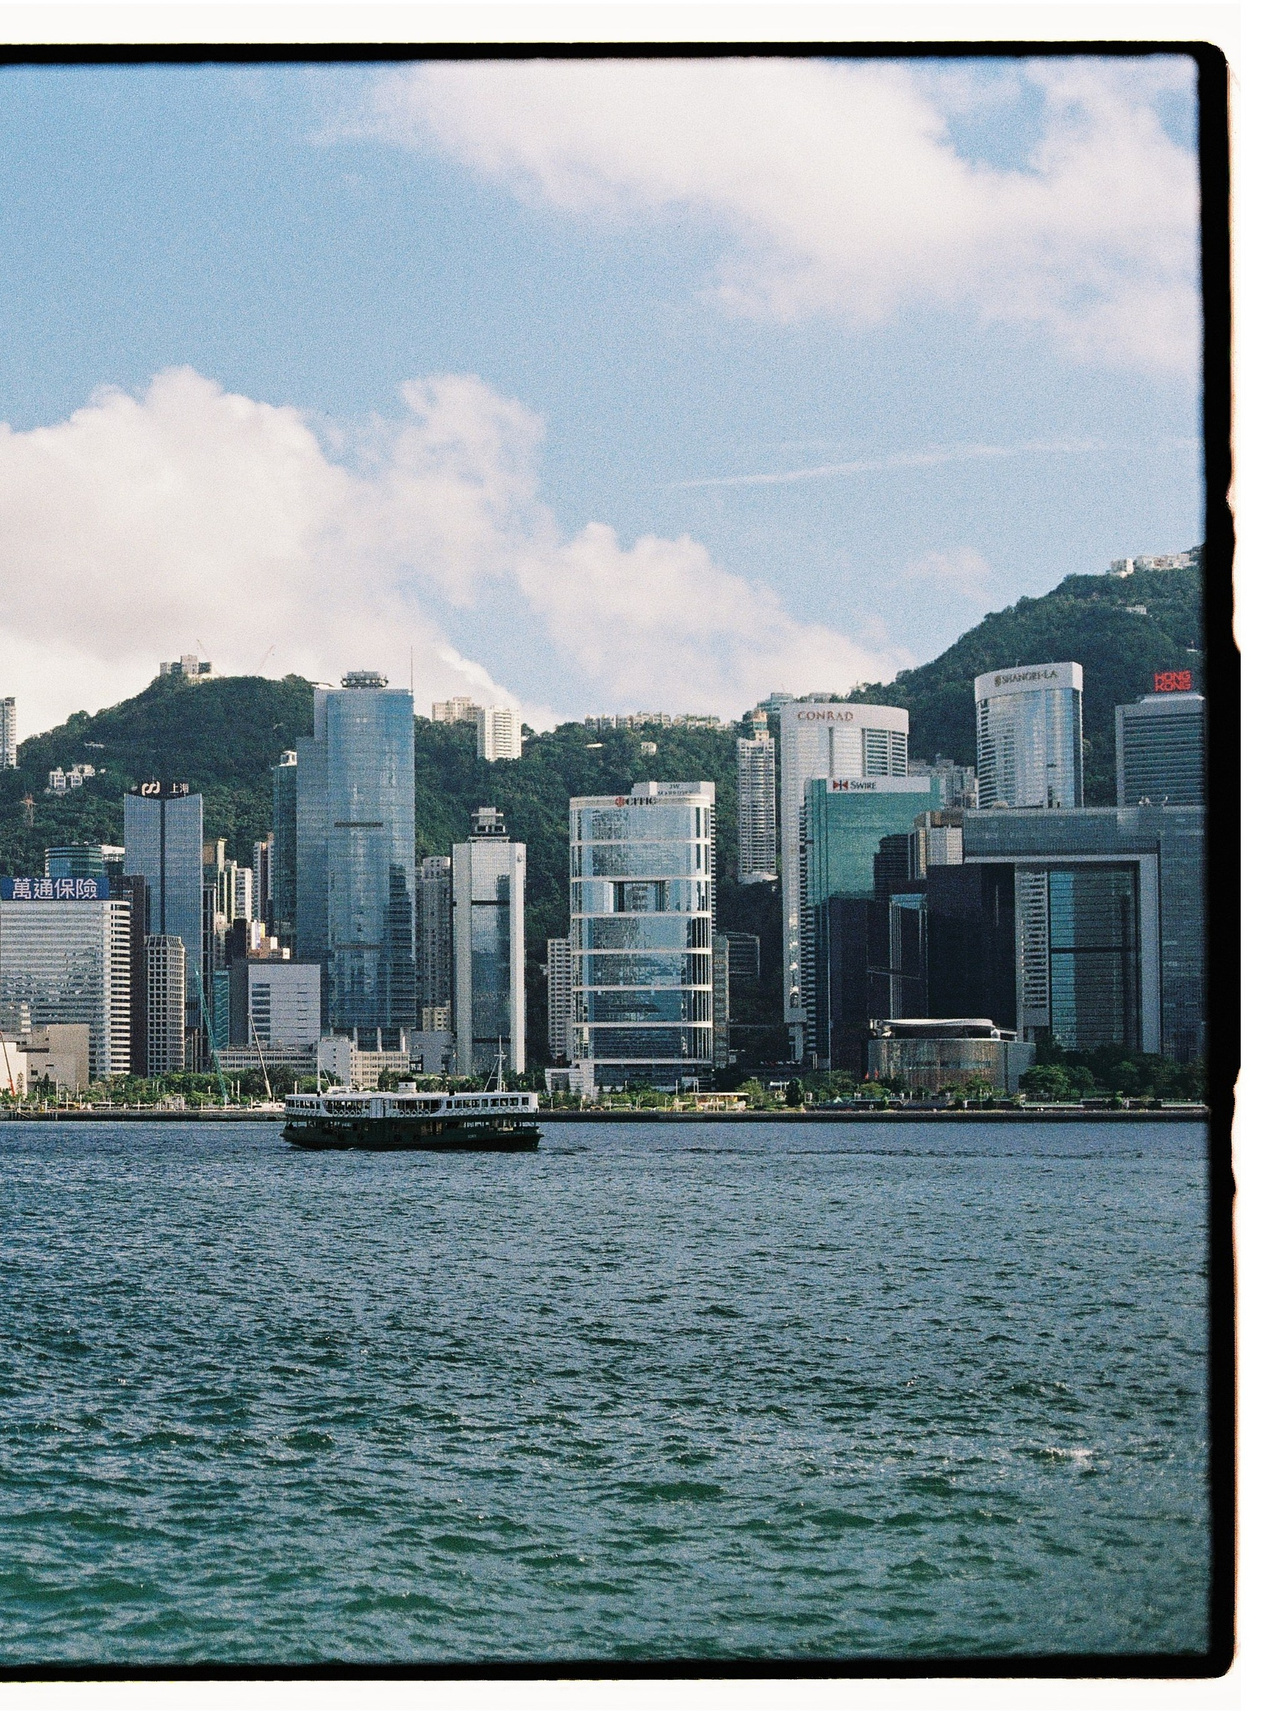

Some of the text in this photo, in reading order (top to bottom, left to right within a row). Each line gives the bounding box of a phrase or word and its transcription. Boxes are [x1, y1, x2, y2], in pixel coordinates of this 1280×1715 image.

[1001, 670, 1058, 684] SHANGRI-LA
[1154, 670, 1190, 682] HONG
[1154, 680, 1190, 691] KONG
[798, 711, 853, 721] CONRAD
[626, 797, 657, 805] CITIC
[12, 878, 97, 899] 萬通保險
